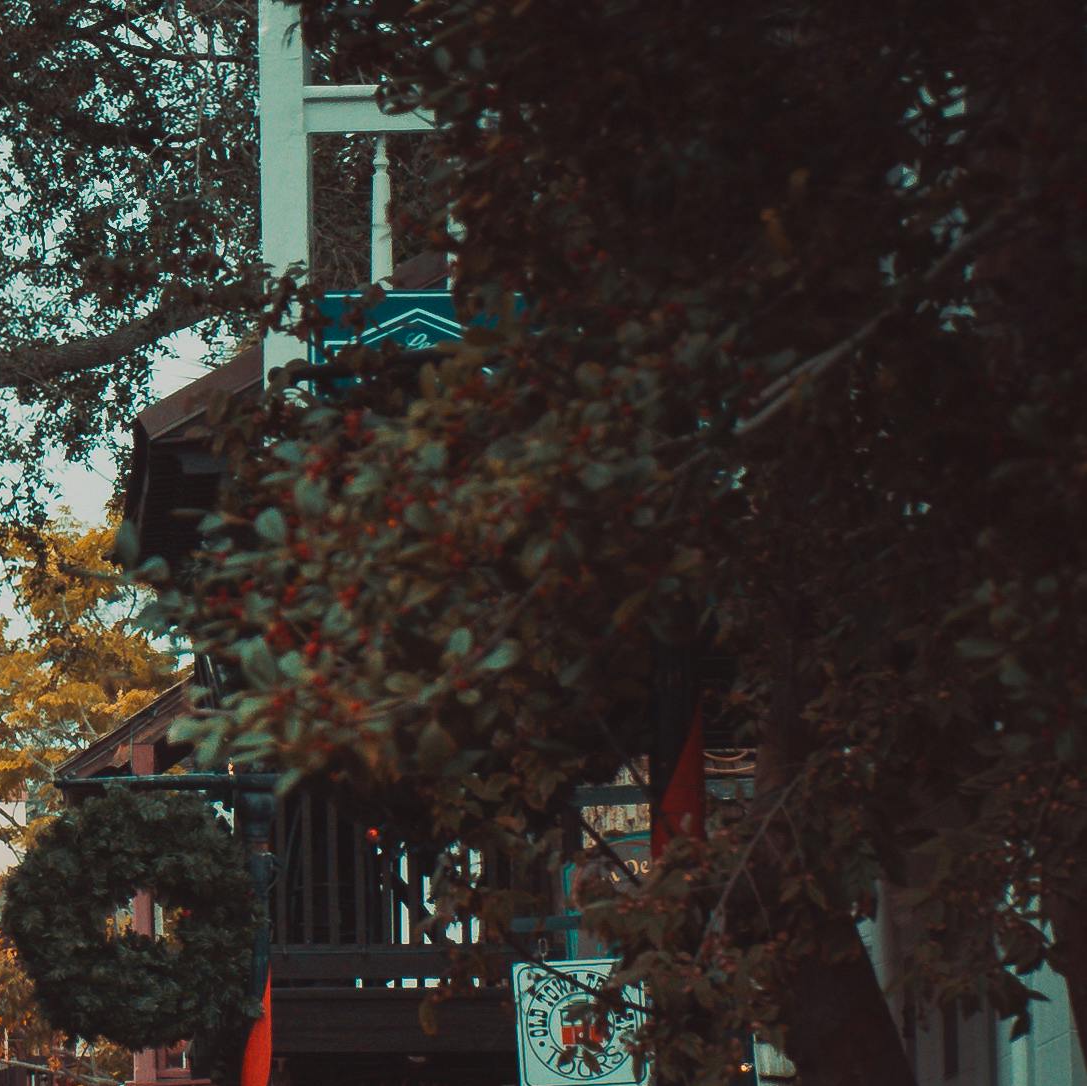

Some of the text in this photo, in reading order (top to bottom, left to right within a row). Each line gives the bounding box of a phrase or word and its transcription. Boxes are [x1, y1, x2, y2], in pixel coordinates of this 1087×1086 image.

[536, 973, 578, 1007] TOWN
[528, 1008, 549, 1038] OLD
[546, 1045, 624, 1078] TOURS
